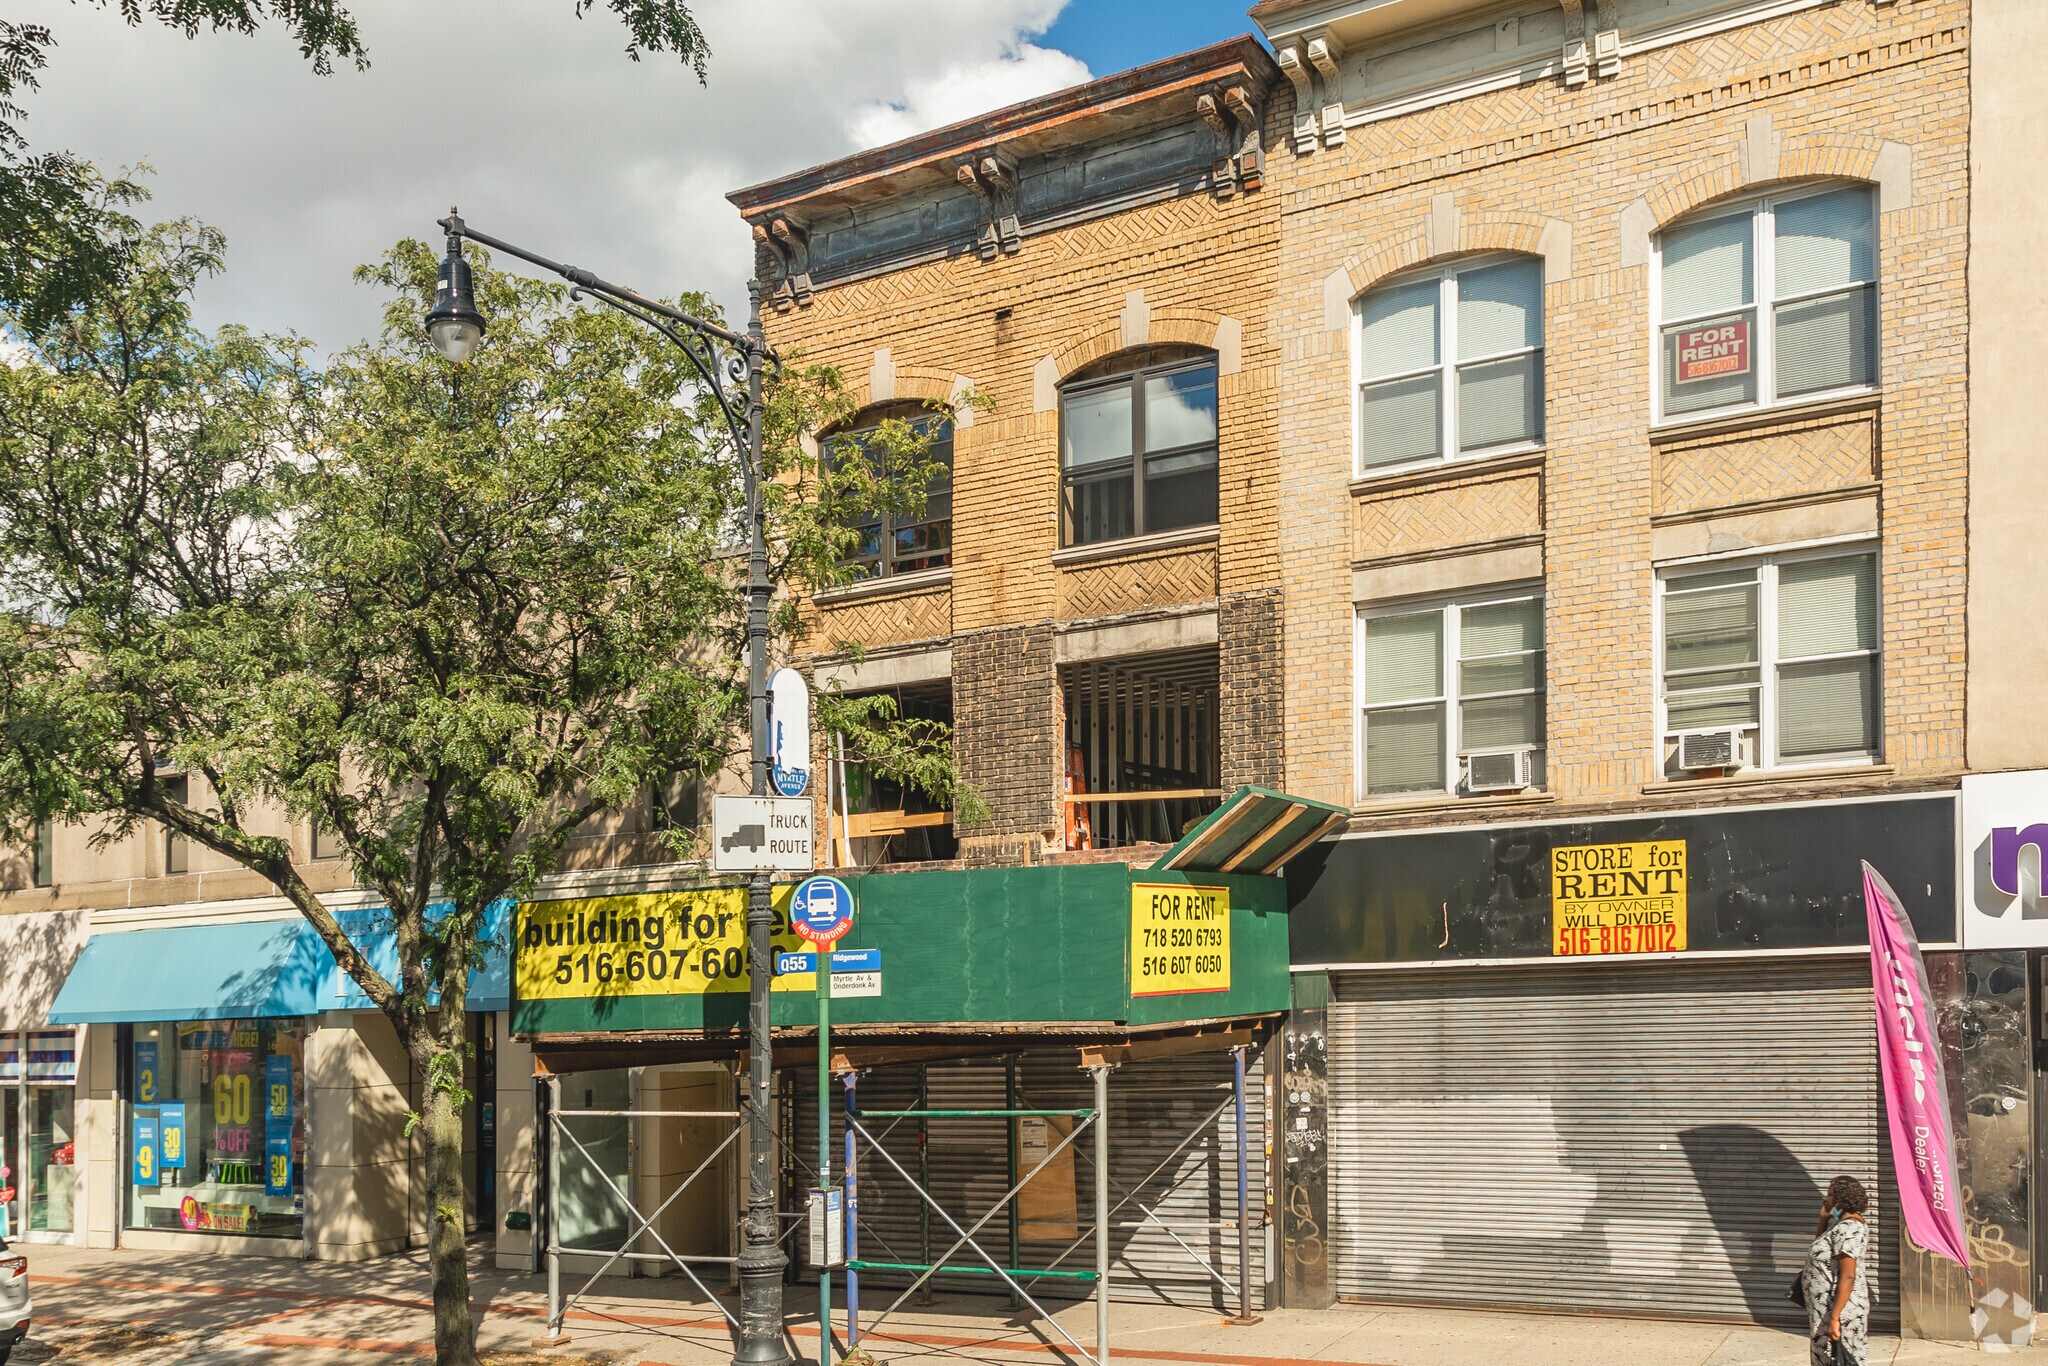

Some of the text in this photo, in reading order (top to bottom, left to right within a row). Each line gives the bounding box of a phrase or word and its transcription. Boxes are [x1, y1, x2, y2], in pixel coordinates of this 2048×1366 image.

[1689, 326, 1736, 347] FOR
[1681, 339, 1744, 363] RENT
[777, 773, 805, 786] MYRTLE
[769, 815, 808, 829] TRUCK
[770, 840, 808, 854] ROUTE
[1555, 845, 1682, 872] STORE for
[1556, 869, 1683, 900] RENT
[1152, 894, 1216, 920] FOR RENT
[1564, 900, 1674, 914] BY OWNER
[525, 909, 665, 950] building
[678, 906, 736, 939] for
[1565, 911, 1674, 928] WILL DIVIDE
[797, 921, 848, 941] NO STANDING
[1143, 928, 1222, 947] 718 520 6793
[555, 945, 787, 985] 516-607-600
[780, 956, 807, 972] Q55
[832, 953, 867, 962] Ridgewood
[1142, 954, 1221, 976] 516 607 6050
[833, 975, 853, 983] Myrtle
[833, 982, 866, 990] Onderdonk
[141, 1069, 153, 1101] 2
[270, 1084, 288, 1106] 50
[214, 1074, 250, 1125] 60
[164, 1127, 181, 1149] 30
[1914, 1125, 1930, 1175] Dealer
[139, 1146, 152, 1179] 9
[270, 1155, 288, 1177] 30
[223, 1215, 244, 1230] SALE!
